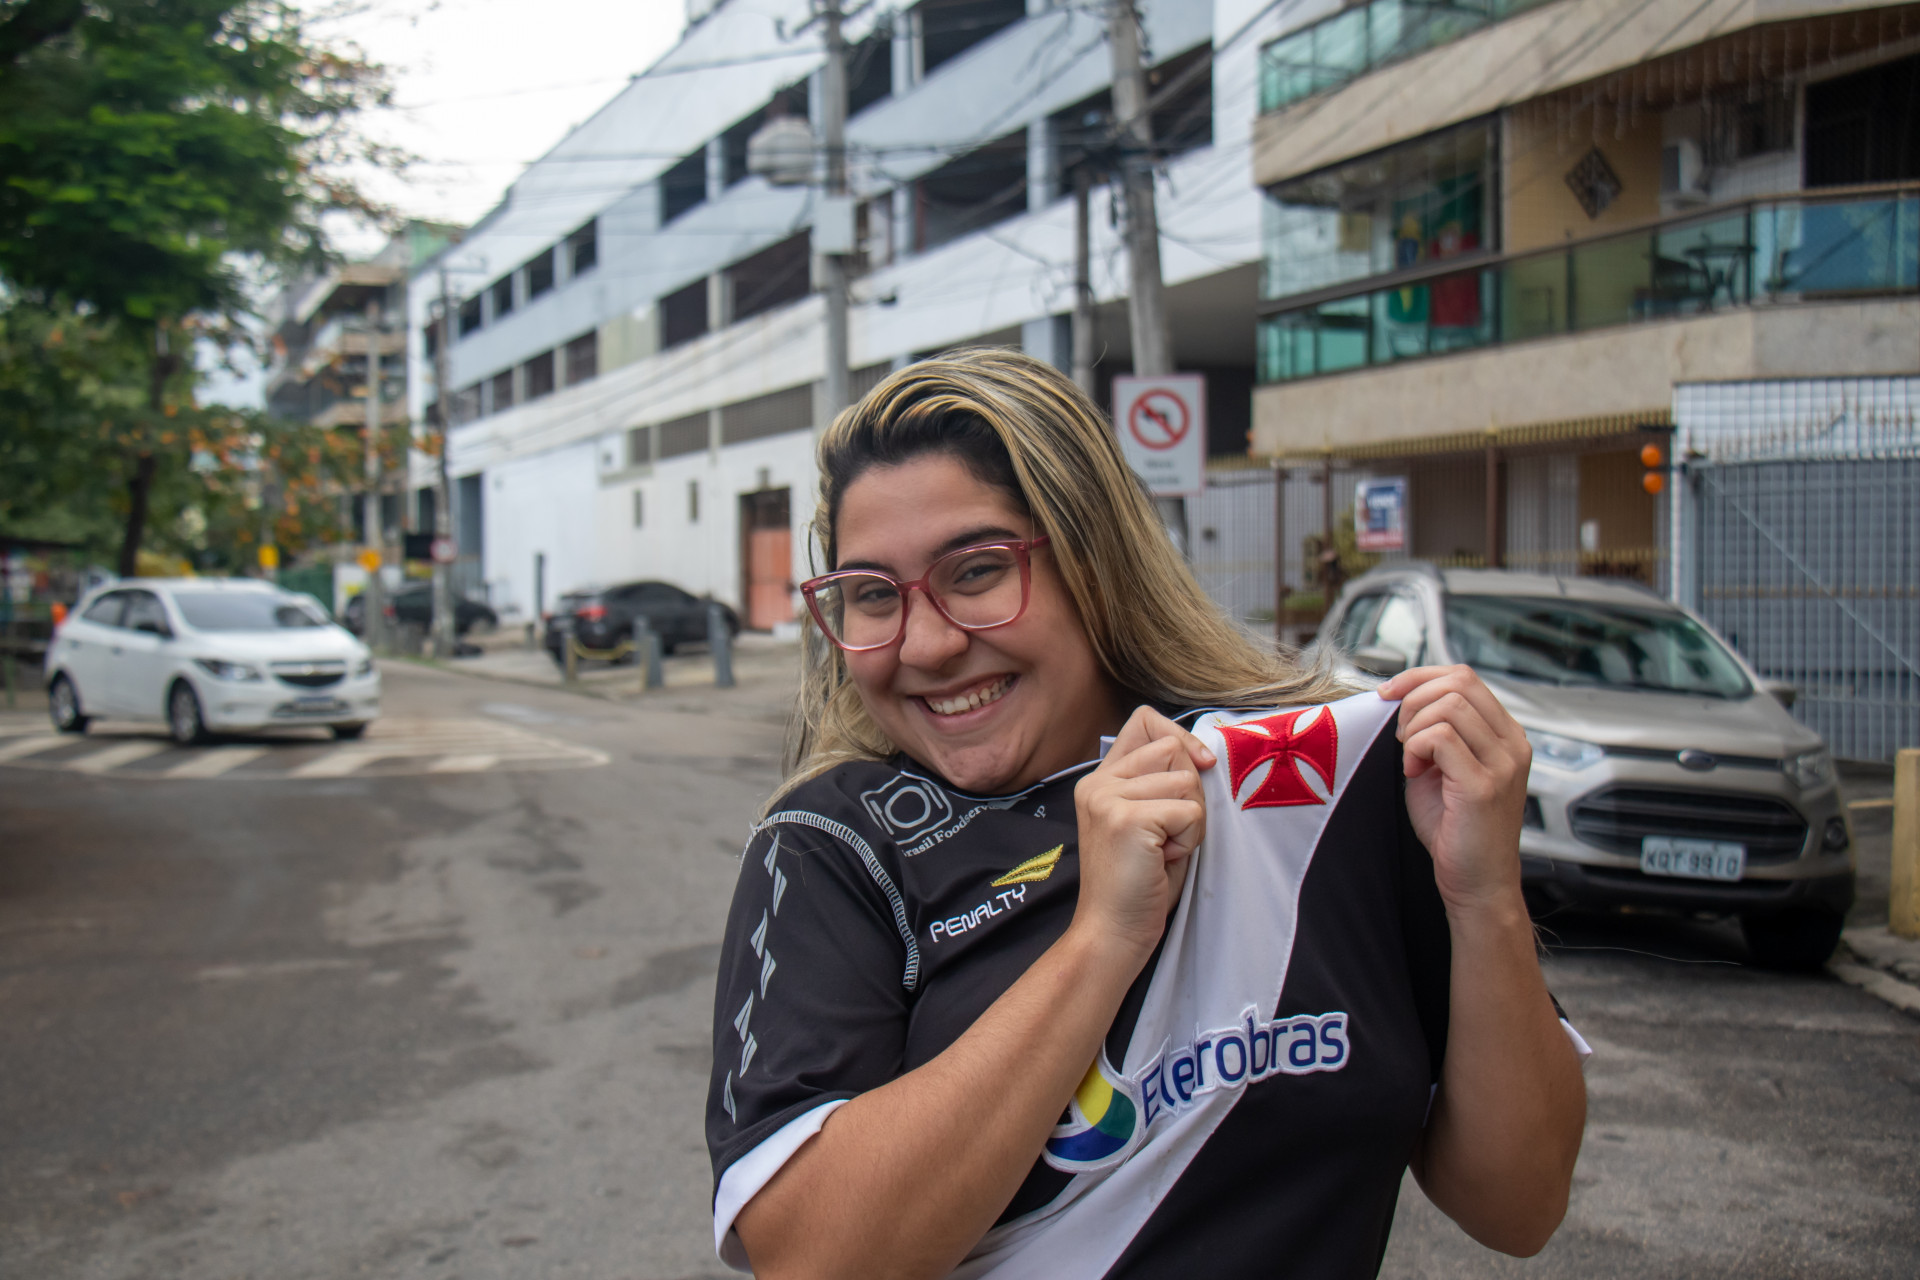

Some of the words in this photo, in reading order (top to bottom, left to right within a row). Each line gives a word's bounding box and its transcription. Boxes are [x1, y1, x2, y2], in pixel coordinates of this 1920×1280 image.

[903, 838, 934, 857] rasil
[929, 884, 1026, 943] PENALTY
[1141, 1015, 1344, 1128] Elerobras
